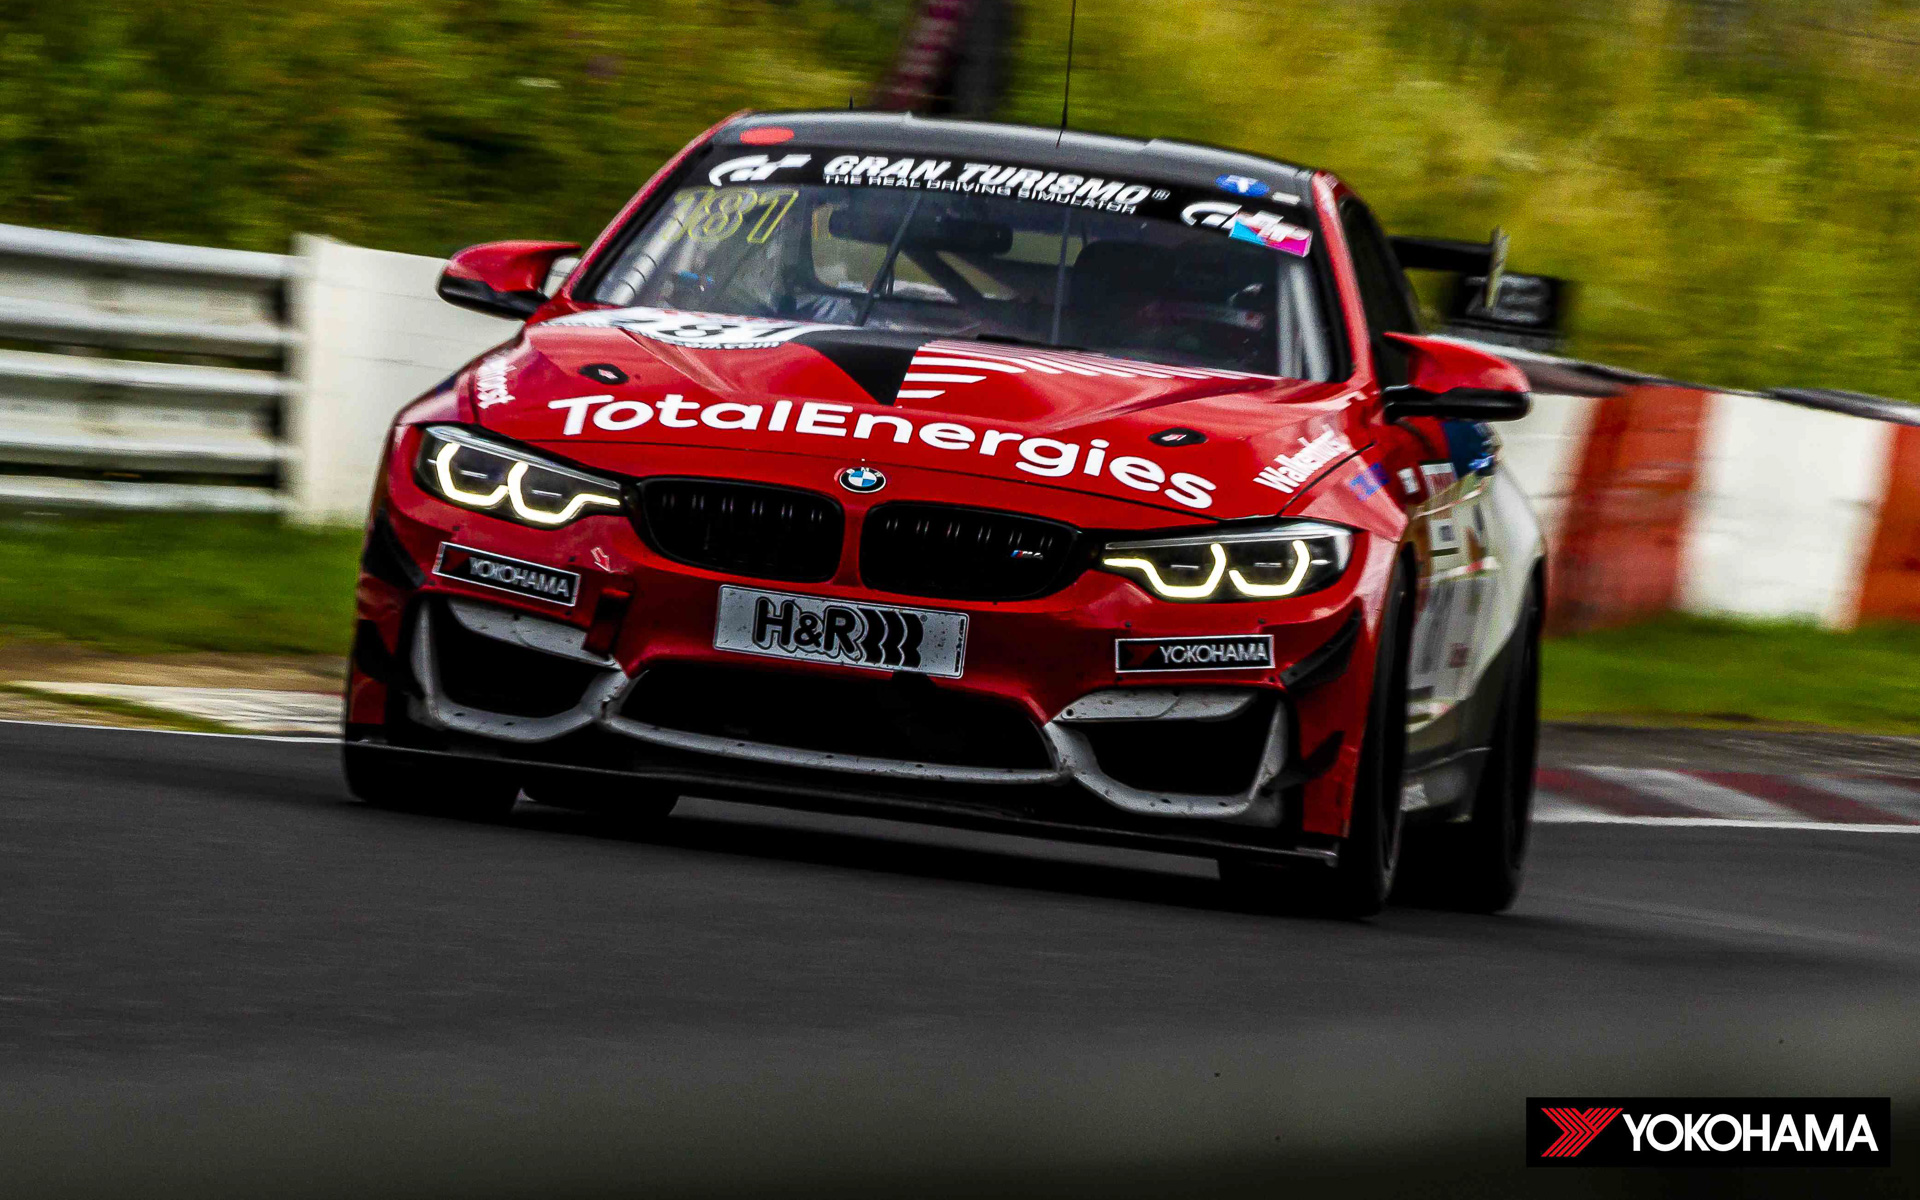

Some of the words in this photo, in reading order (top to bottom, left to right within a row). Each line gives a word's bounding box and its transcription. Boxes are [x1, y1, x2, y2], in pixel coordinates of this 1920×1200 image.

[823, 154, 952, 181] GRAN
[957, 162, 1152, 206] TURISMO
[823, 174, 862, 186] THE
[868, 176, 921, 189] REAL
[926, 178, 1011, 197] DRIVING
[1017, 187, 1138, 215] SIMULATOR
[547, 394, 1217, 510] TotalEnergies
[468, 556, 570, 598] YOKOHAMA
[753, 596, 865, 662] H&R
[1159, 642, 1269, 665] YOKOHAMA
